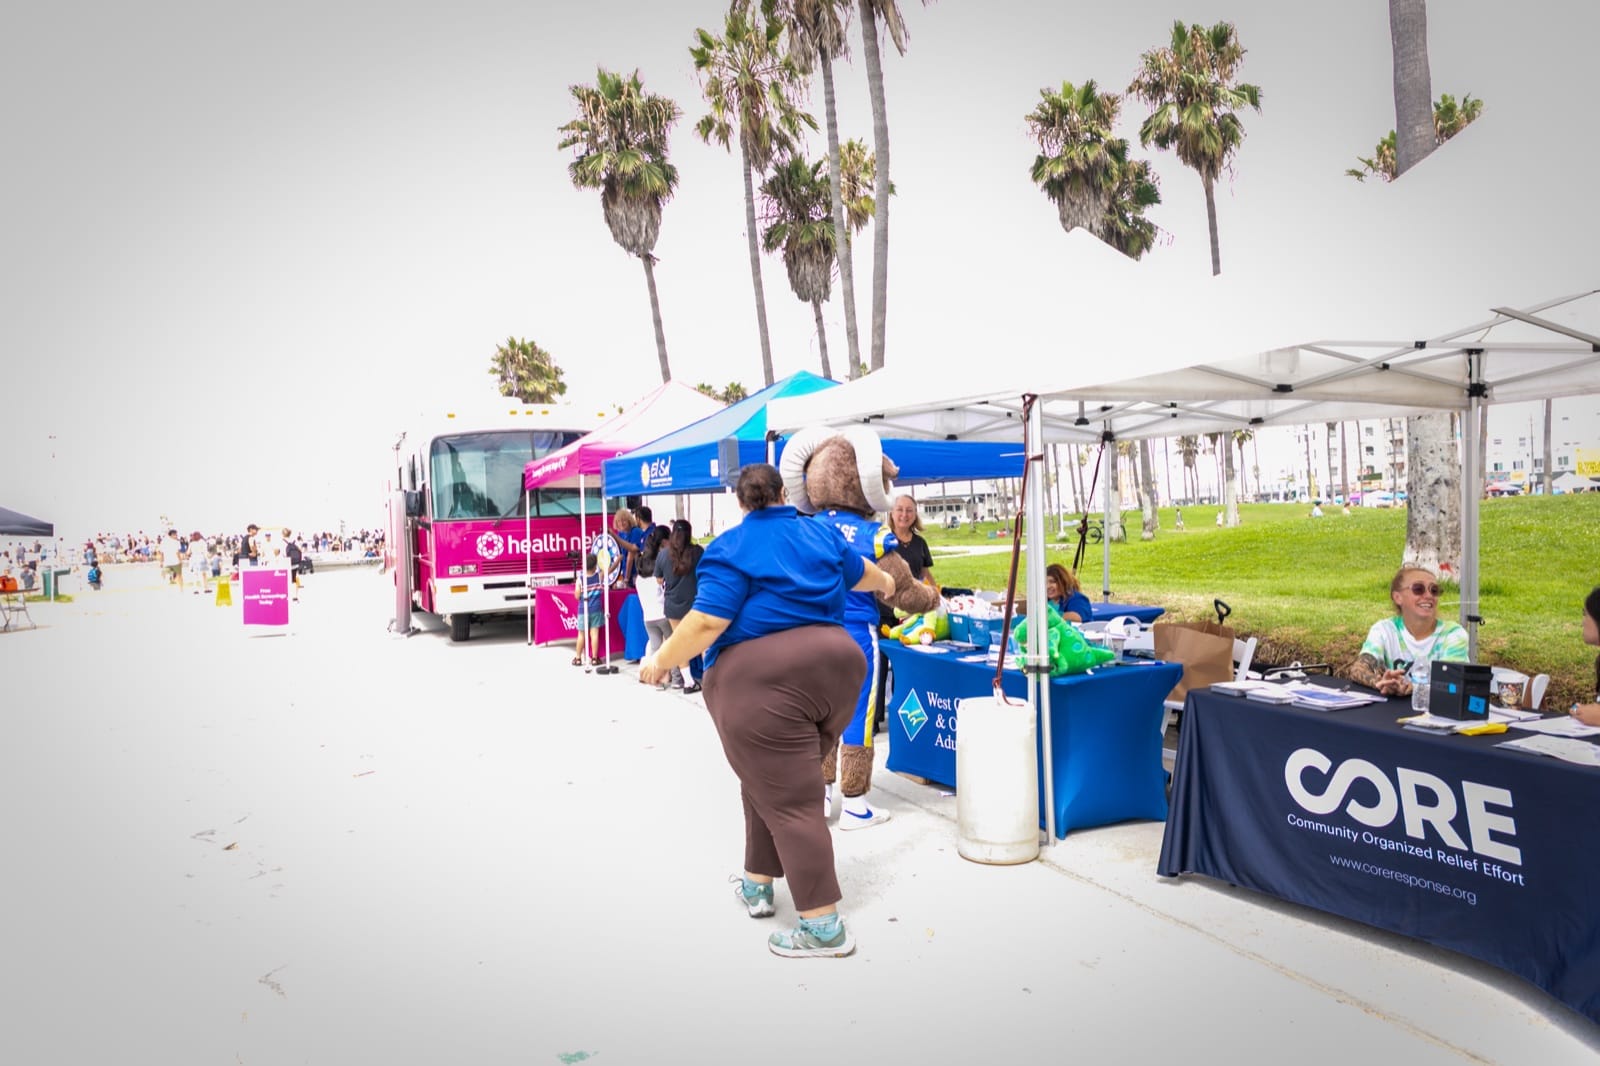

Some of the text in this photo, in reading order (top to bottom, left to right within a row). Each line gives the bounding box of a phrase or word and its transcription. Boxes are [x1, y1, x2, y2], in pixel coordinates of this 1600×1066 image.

[507, 532, 567, 554] health
[926, 690, 952, 711] West
[935, 713, 946, 729] &
[1284, 747, 1522, 866] CORE
[1287, 813, 1525, 887] Community Organized Relief Effort
[1329, 854, 1477, 906] www.coreresponse.org
